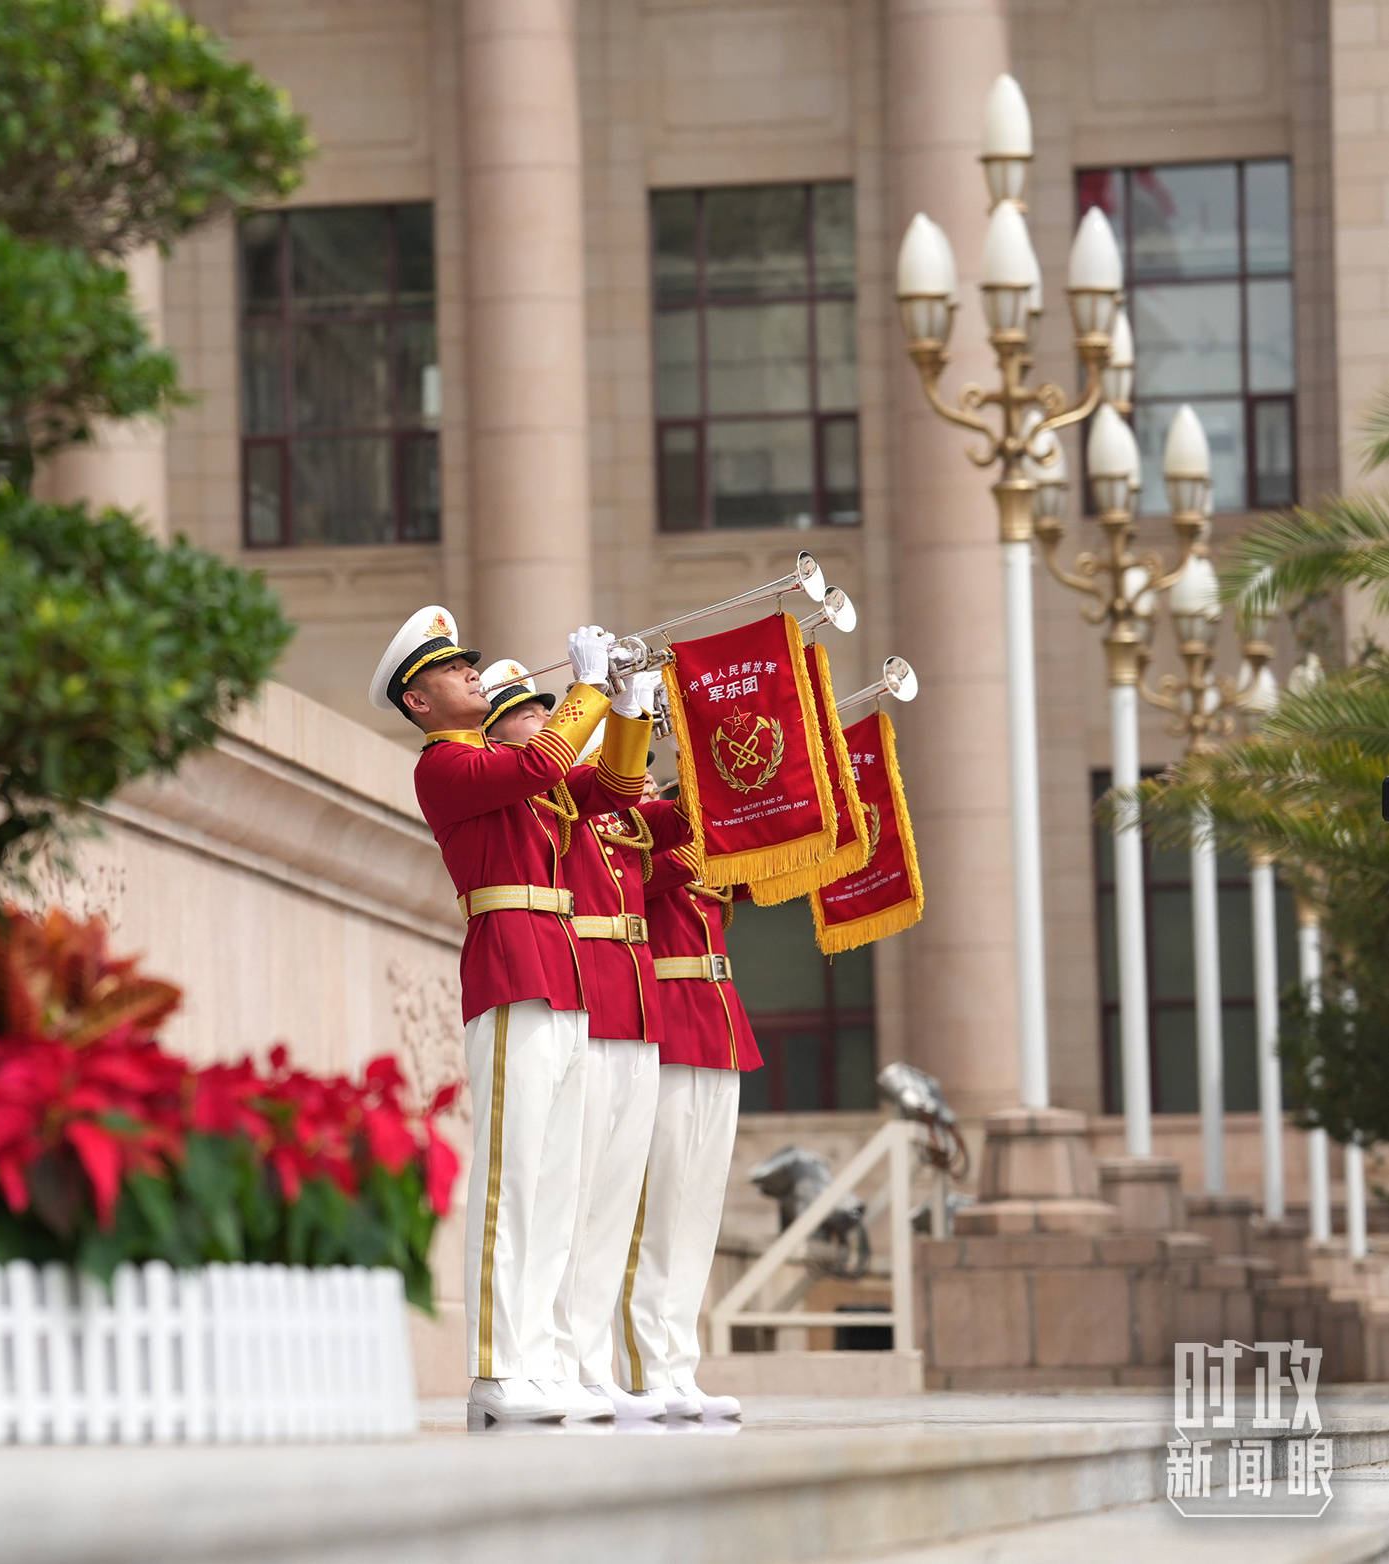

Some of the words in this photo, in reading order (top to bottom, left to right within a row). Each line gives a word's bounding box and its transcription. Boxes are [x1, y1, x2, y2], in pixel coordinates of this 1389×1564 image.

[689, 661, 777, 692] 中国人民解放军
[708, 675, 759, 703] 军乐团
[723, 816, 744, 826] CHINESE
[765, 804, 792, 816] LIBERATION
[793, 799, 809, 809] ARMY
